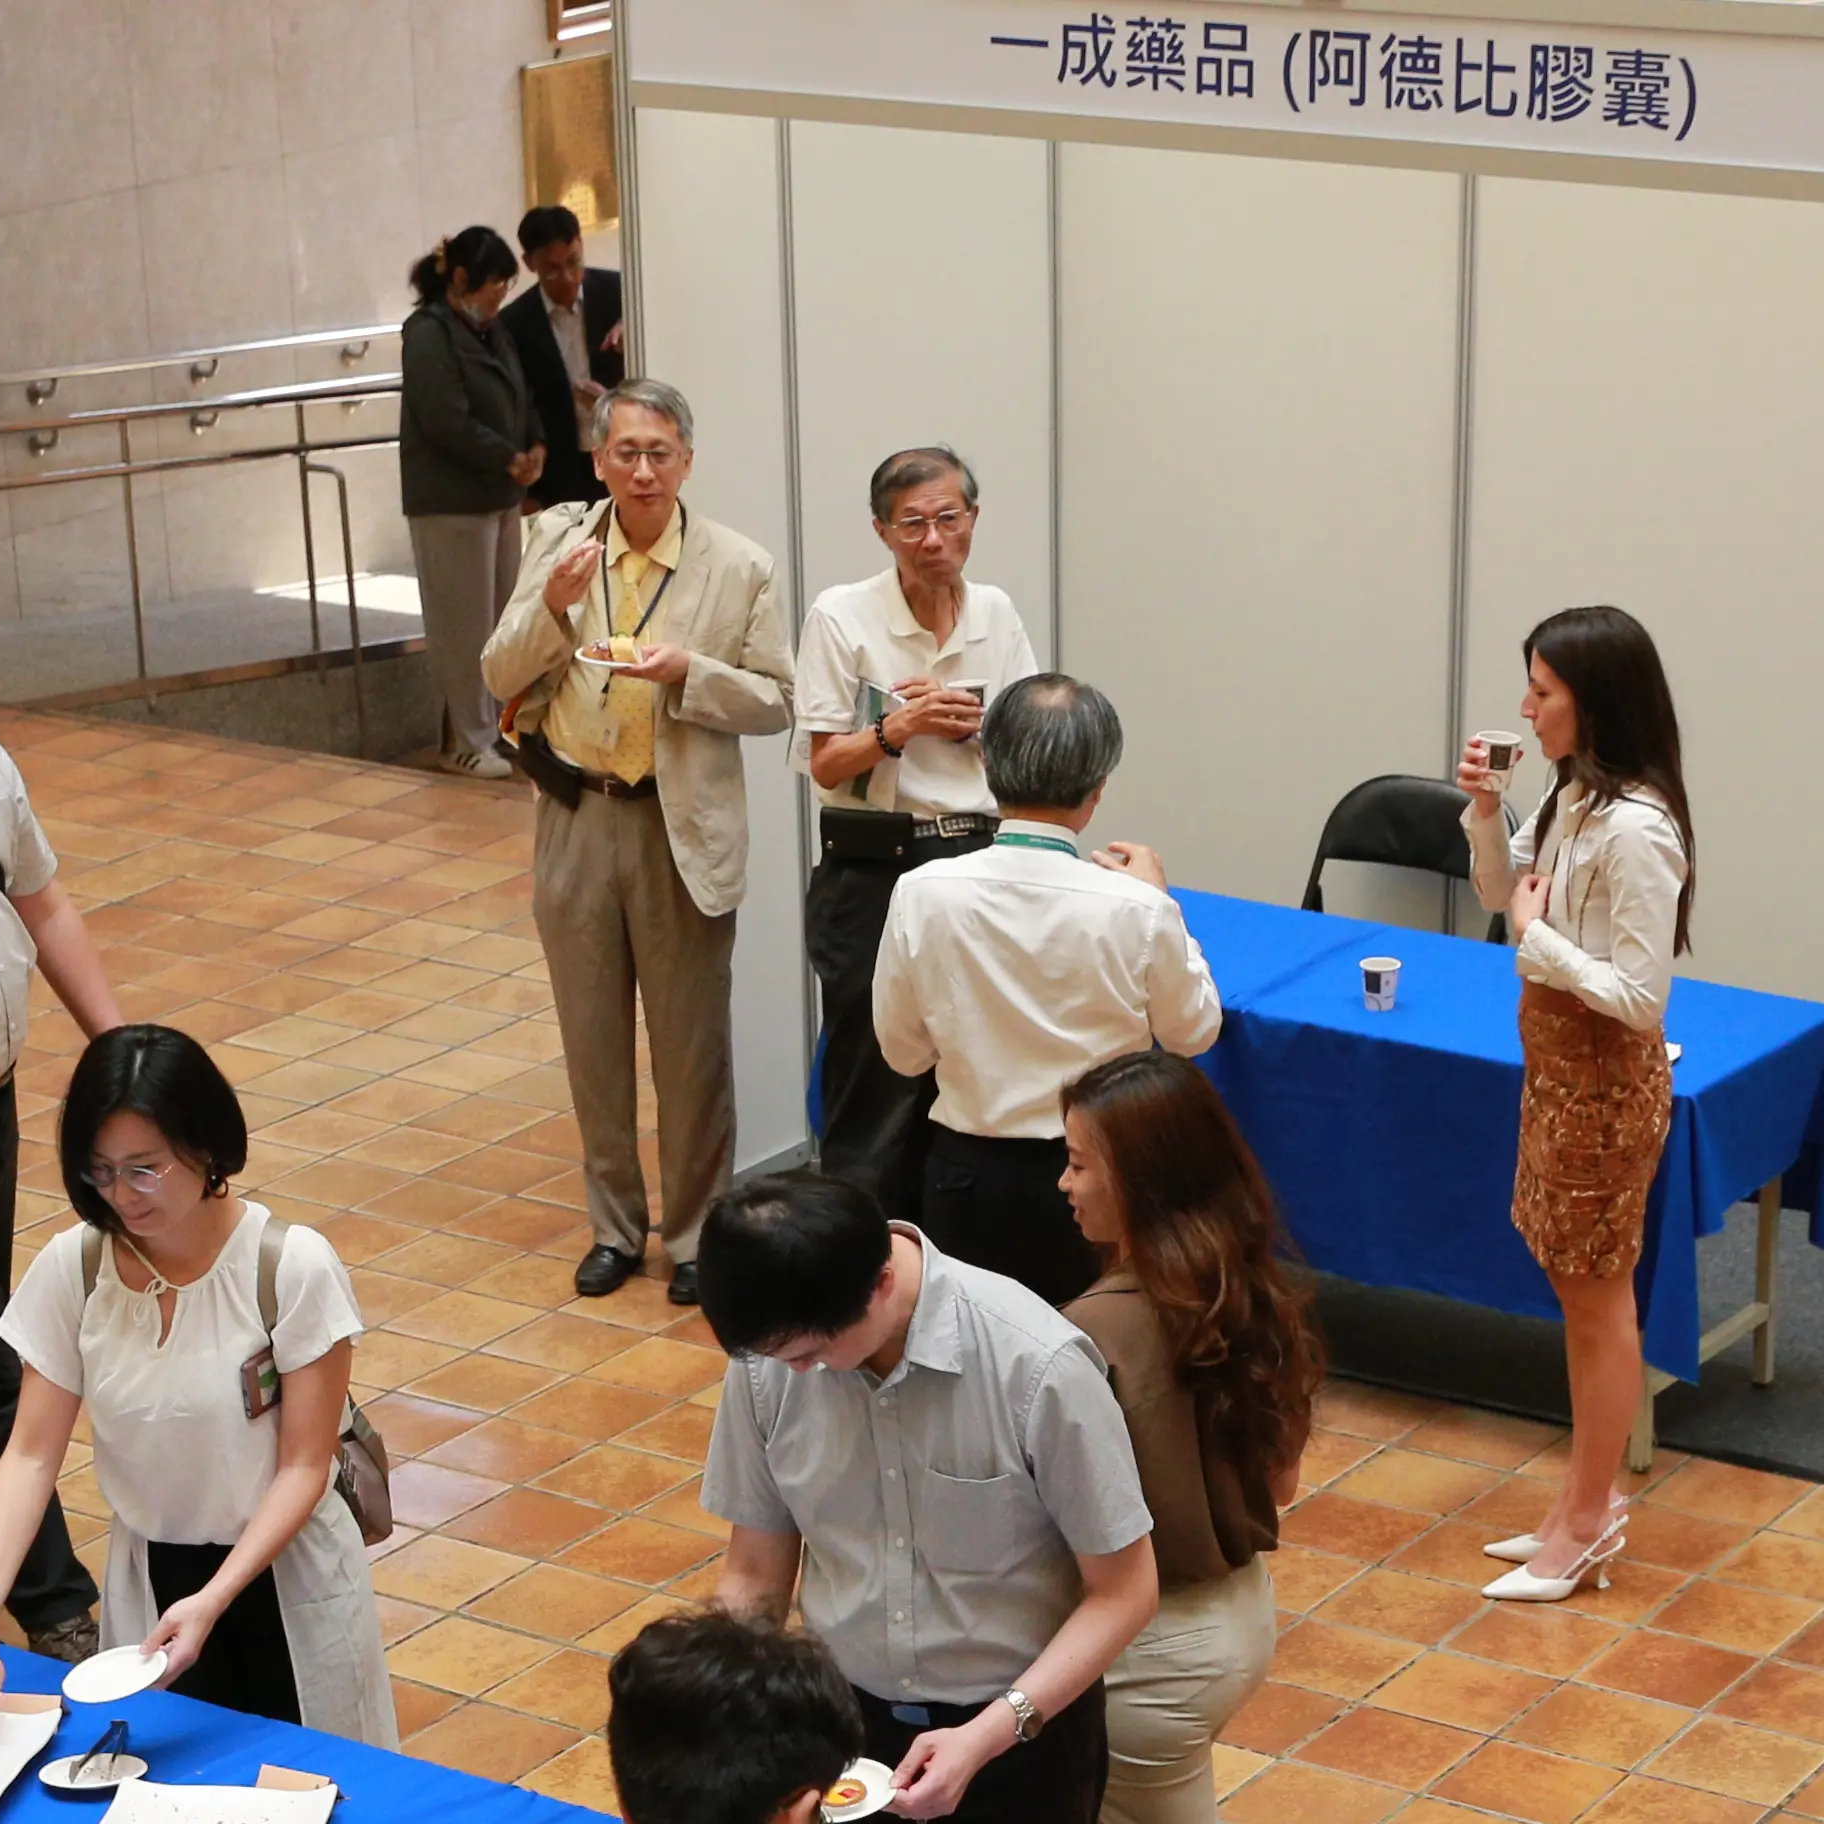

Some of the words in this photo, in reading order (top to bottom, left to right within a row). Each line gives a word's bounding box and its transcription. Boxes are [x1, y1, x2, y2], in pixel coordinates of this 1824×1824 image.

[989, 12, 1256, 98] 一成藥品
[1282, 28, 1699, 140] (阿德比膠囊)
